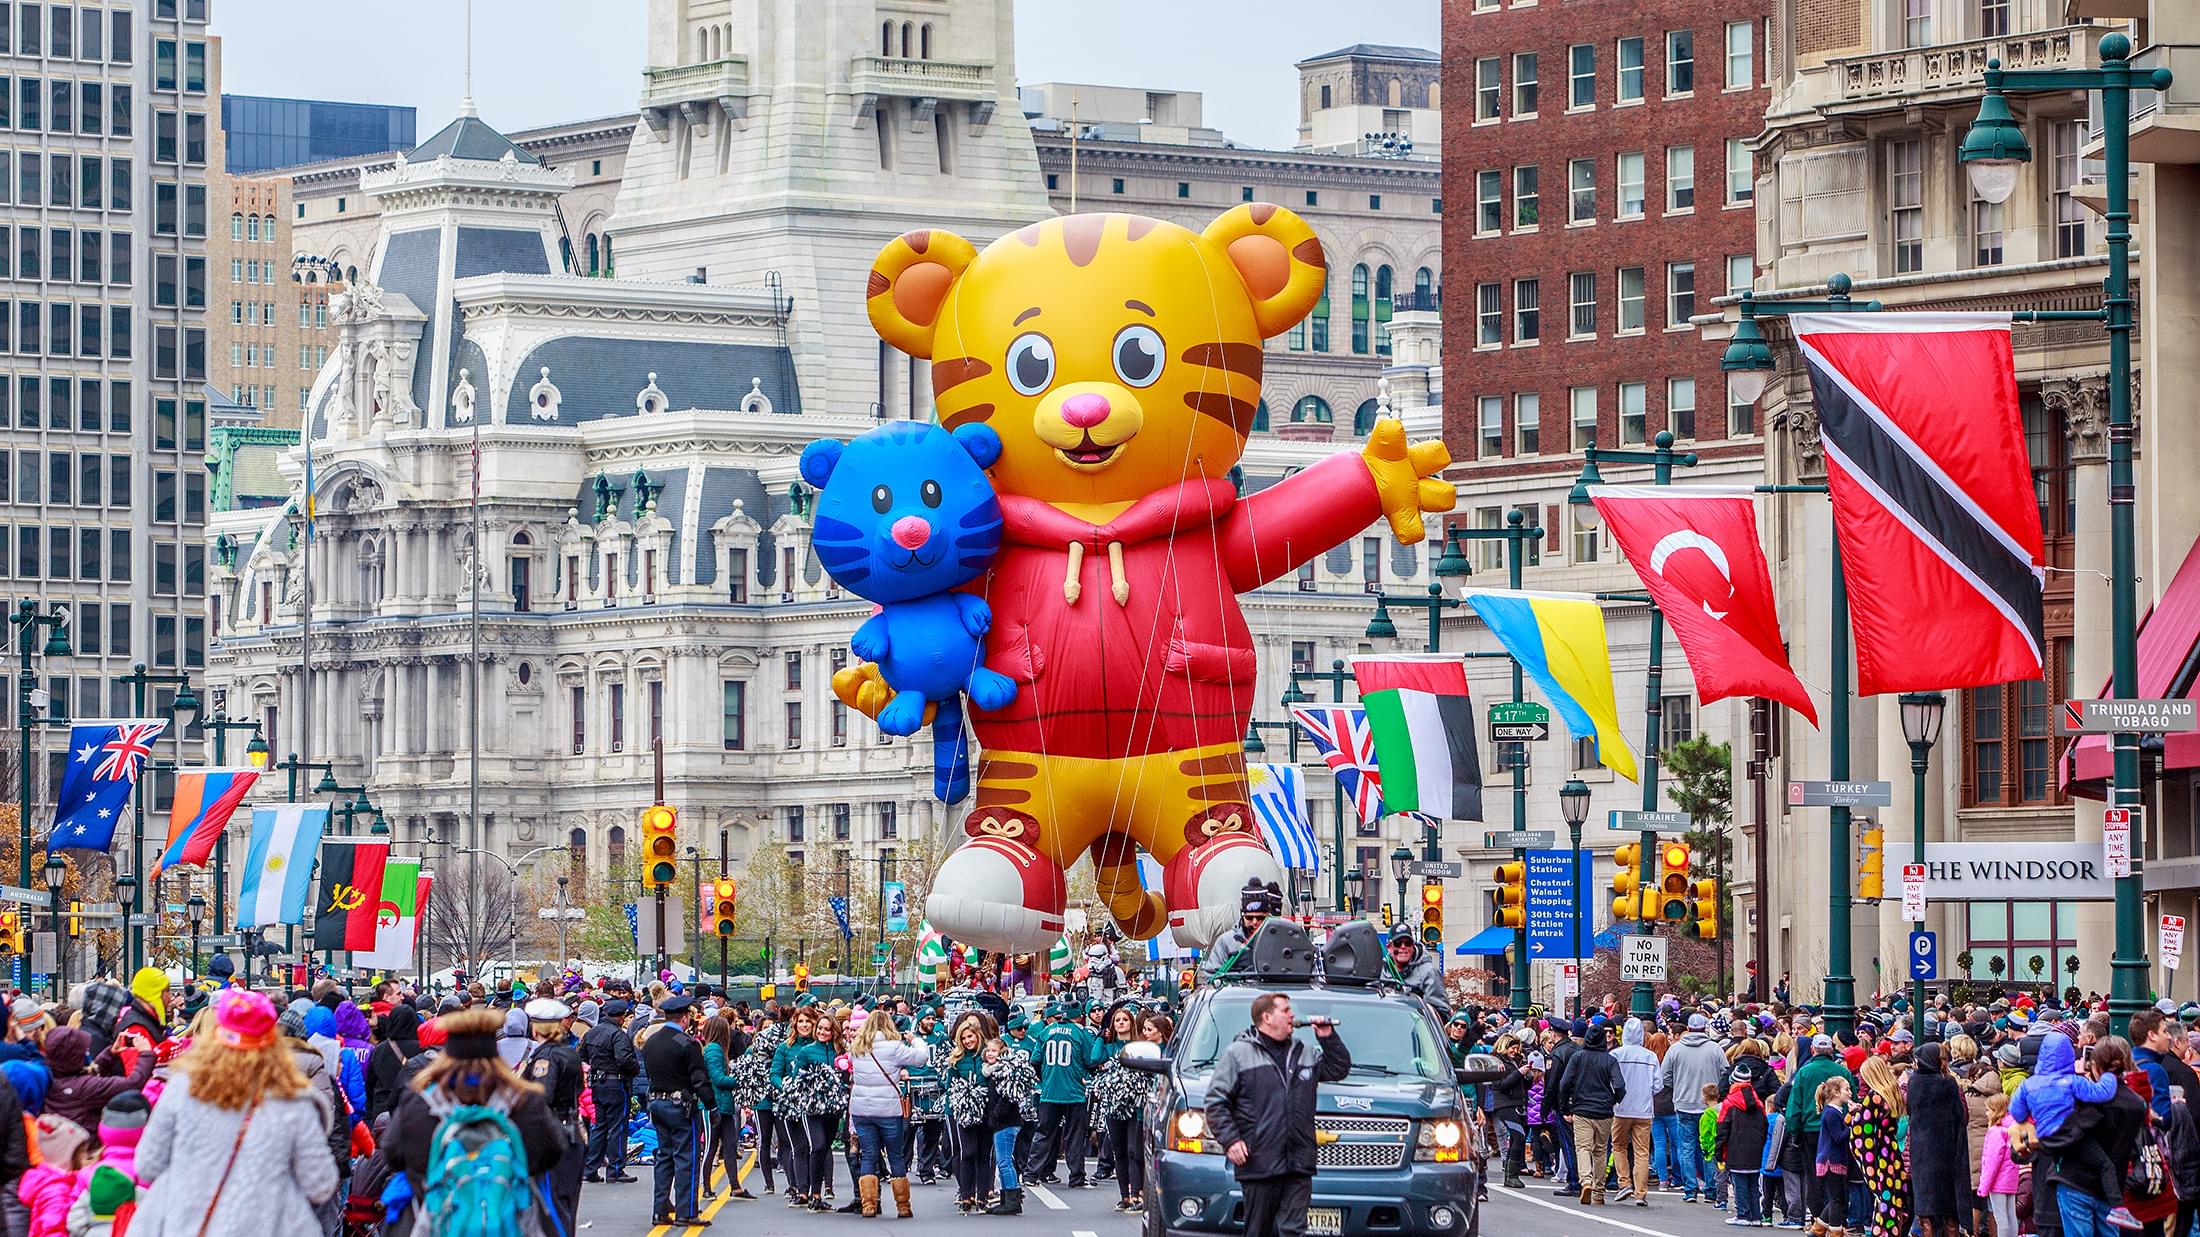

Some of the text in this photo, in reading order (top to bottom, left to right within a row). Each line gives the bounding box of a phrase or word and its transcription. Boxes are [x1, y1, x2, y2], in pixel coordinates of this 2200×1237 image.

[2090, 704, 2192, 715] TRINIDAD AND
[1504, 710, 1527, 721] 17TH
[2112, 716, 2170, 727] TOBAGO
[1825, 784, 1869, 794] TURKEY
[1638, 814, 1676, 822] UKRAINE
[2112, 810, 2122, 822] NO
[2108, 844, 2124, 852] TIME
[1910, 866, 1918, 874] NO
[1912, 860, 2098, 880] HE WINDSOR
[10, 891, 44, 900] AUSTRALIA
[2168, 916, 2176, 925] NO
[1637, 940, 1652, 950] NO
[1920, 940, 1928, 952] P
[1630, 952, 1660, 962] TURN
[1624, 964, 1664, 974] ON RED
[1046, 1040, 1072, 1066] 00
[1308, 1214, 1340, 1228] XTRAX
